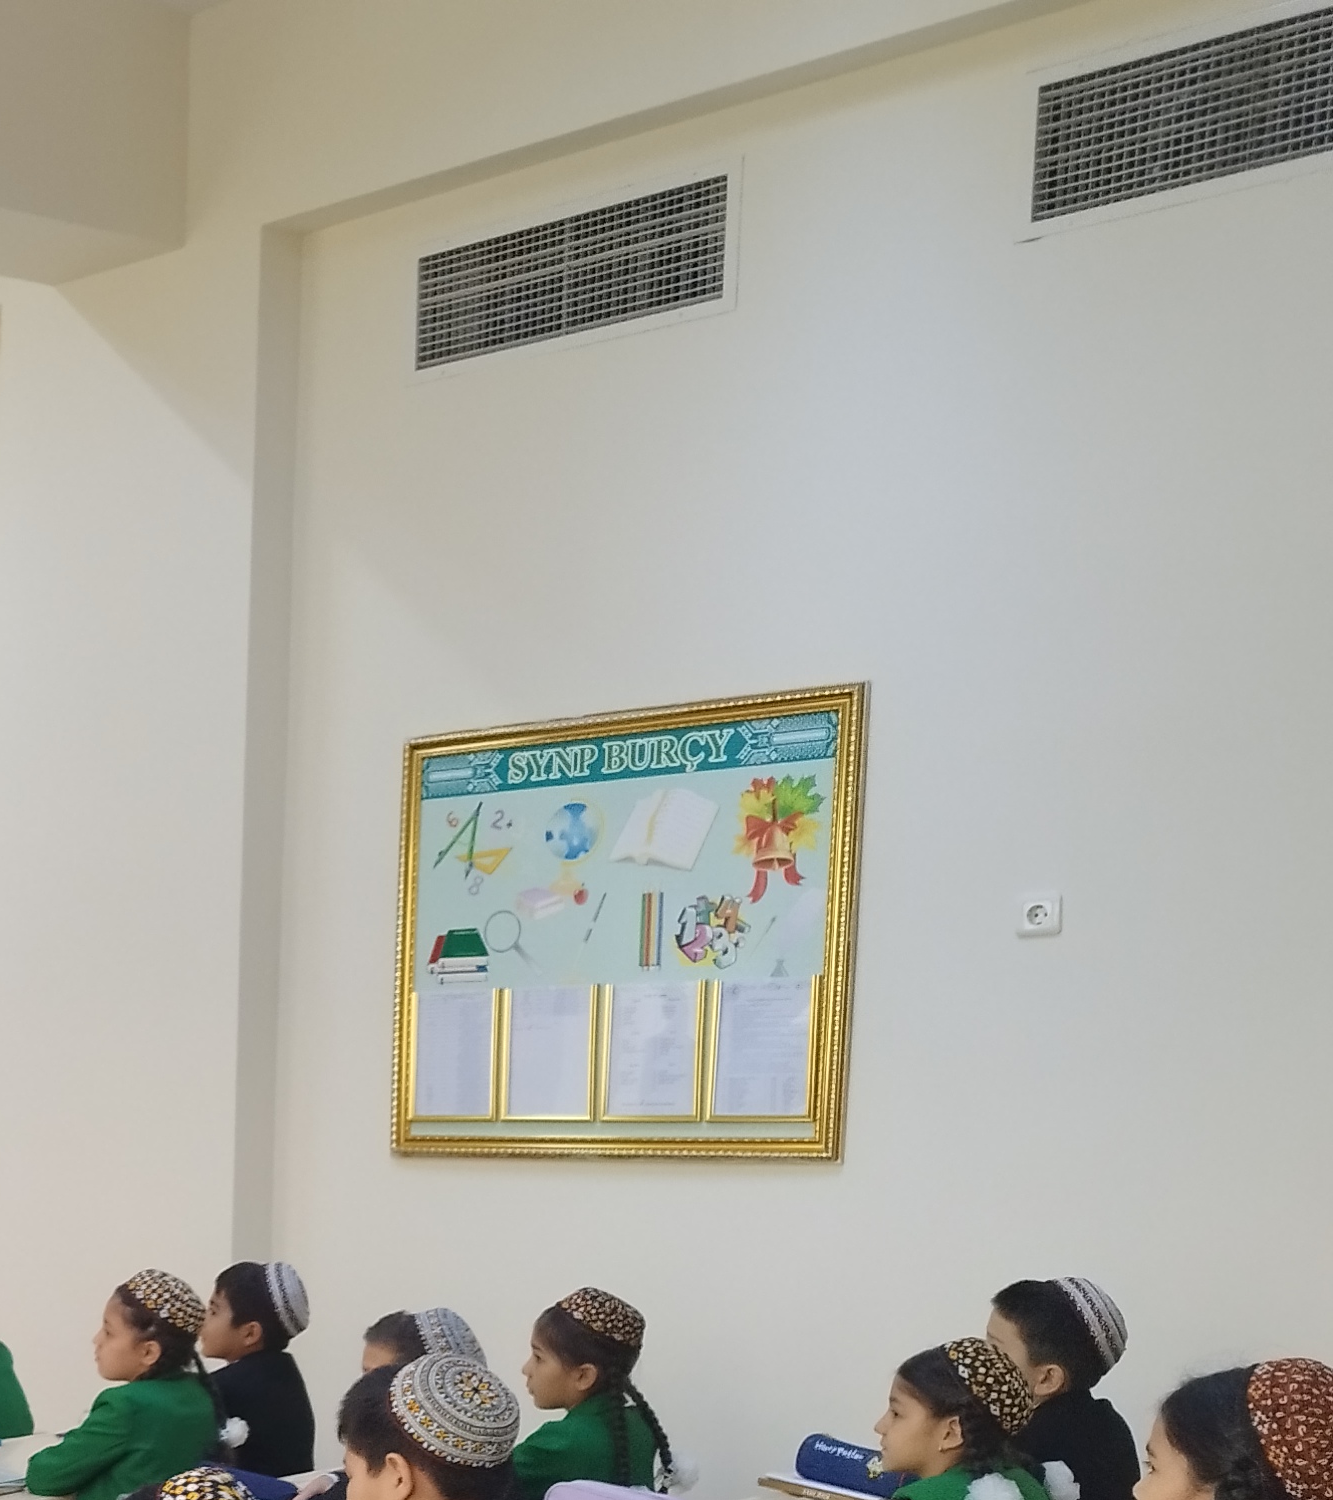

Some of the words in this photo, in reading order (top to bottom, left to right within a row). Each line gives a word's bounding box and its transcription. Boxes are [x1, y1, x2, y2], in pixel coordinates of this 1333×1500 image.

[507, 745, 598, 785] SYNP
[603, 729, 735, 773] BURÇY
[446, 811, 459, 828] 6
[468, 875, 484, 895] 8
